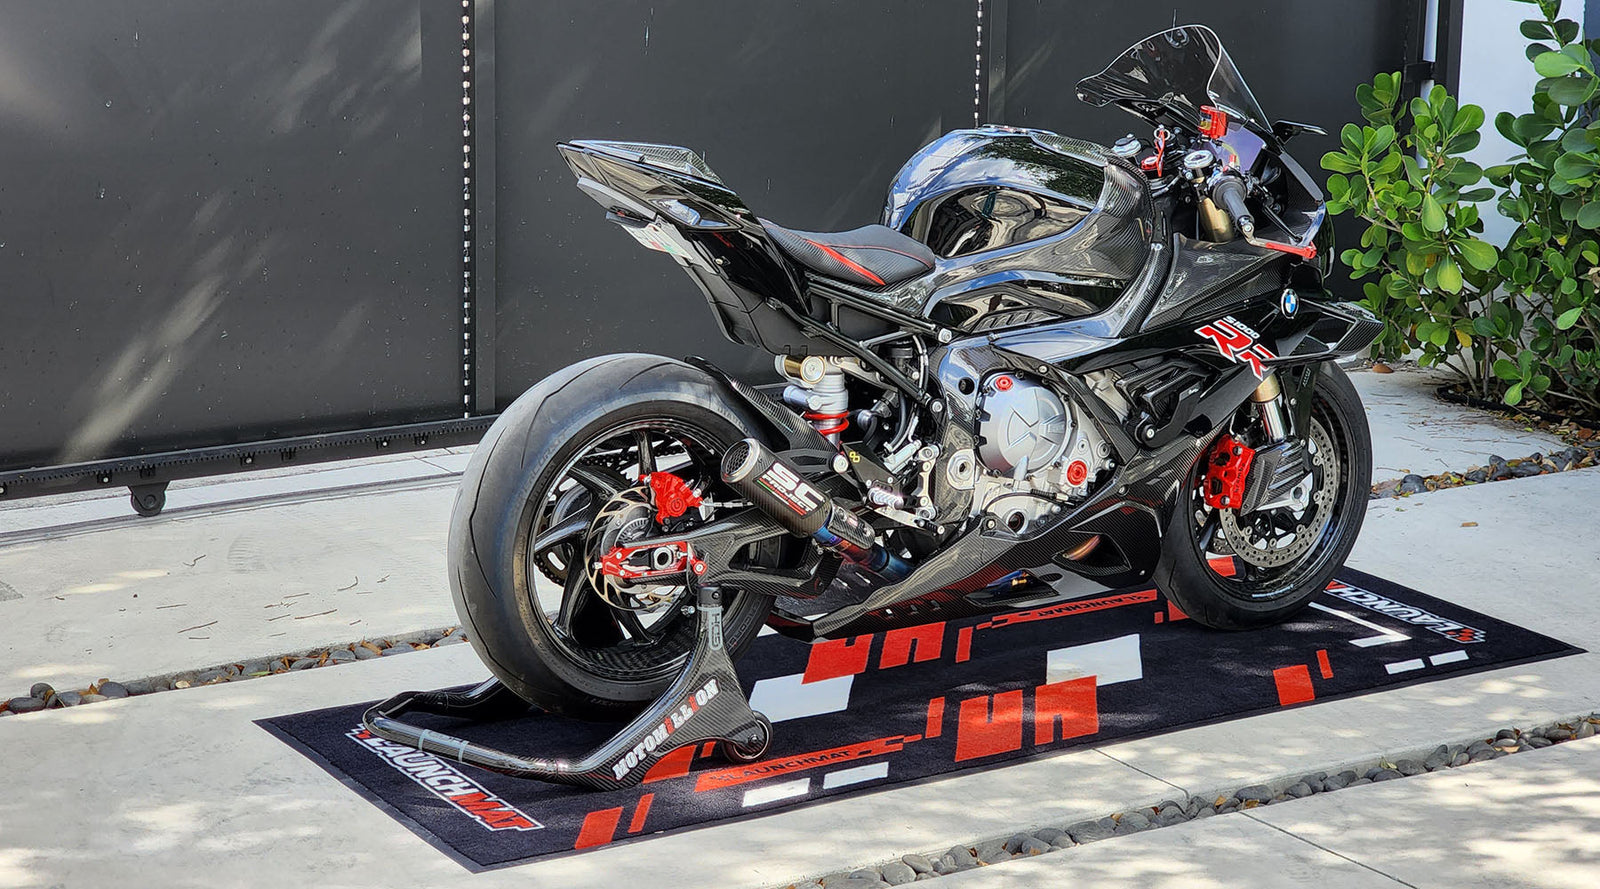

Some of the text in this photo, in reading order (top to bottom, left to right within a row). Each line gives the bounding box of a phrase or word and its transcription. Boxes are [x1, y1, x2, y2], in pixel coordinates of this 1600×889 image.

[1223, 315, 1261, 339] S1000
[762, 473, 813, 512] PROJECT
[766, 462, 826, 510] SC
[1038, 595, 1138, 617] LAUNCHMAT
[729, 750, 850, 780] LAUNCHMAT
[366, 736, 540, 830] LAUNCHMAT
